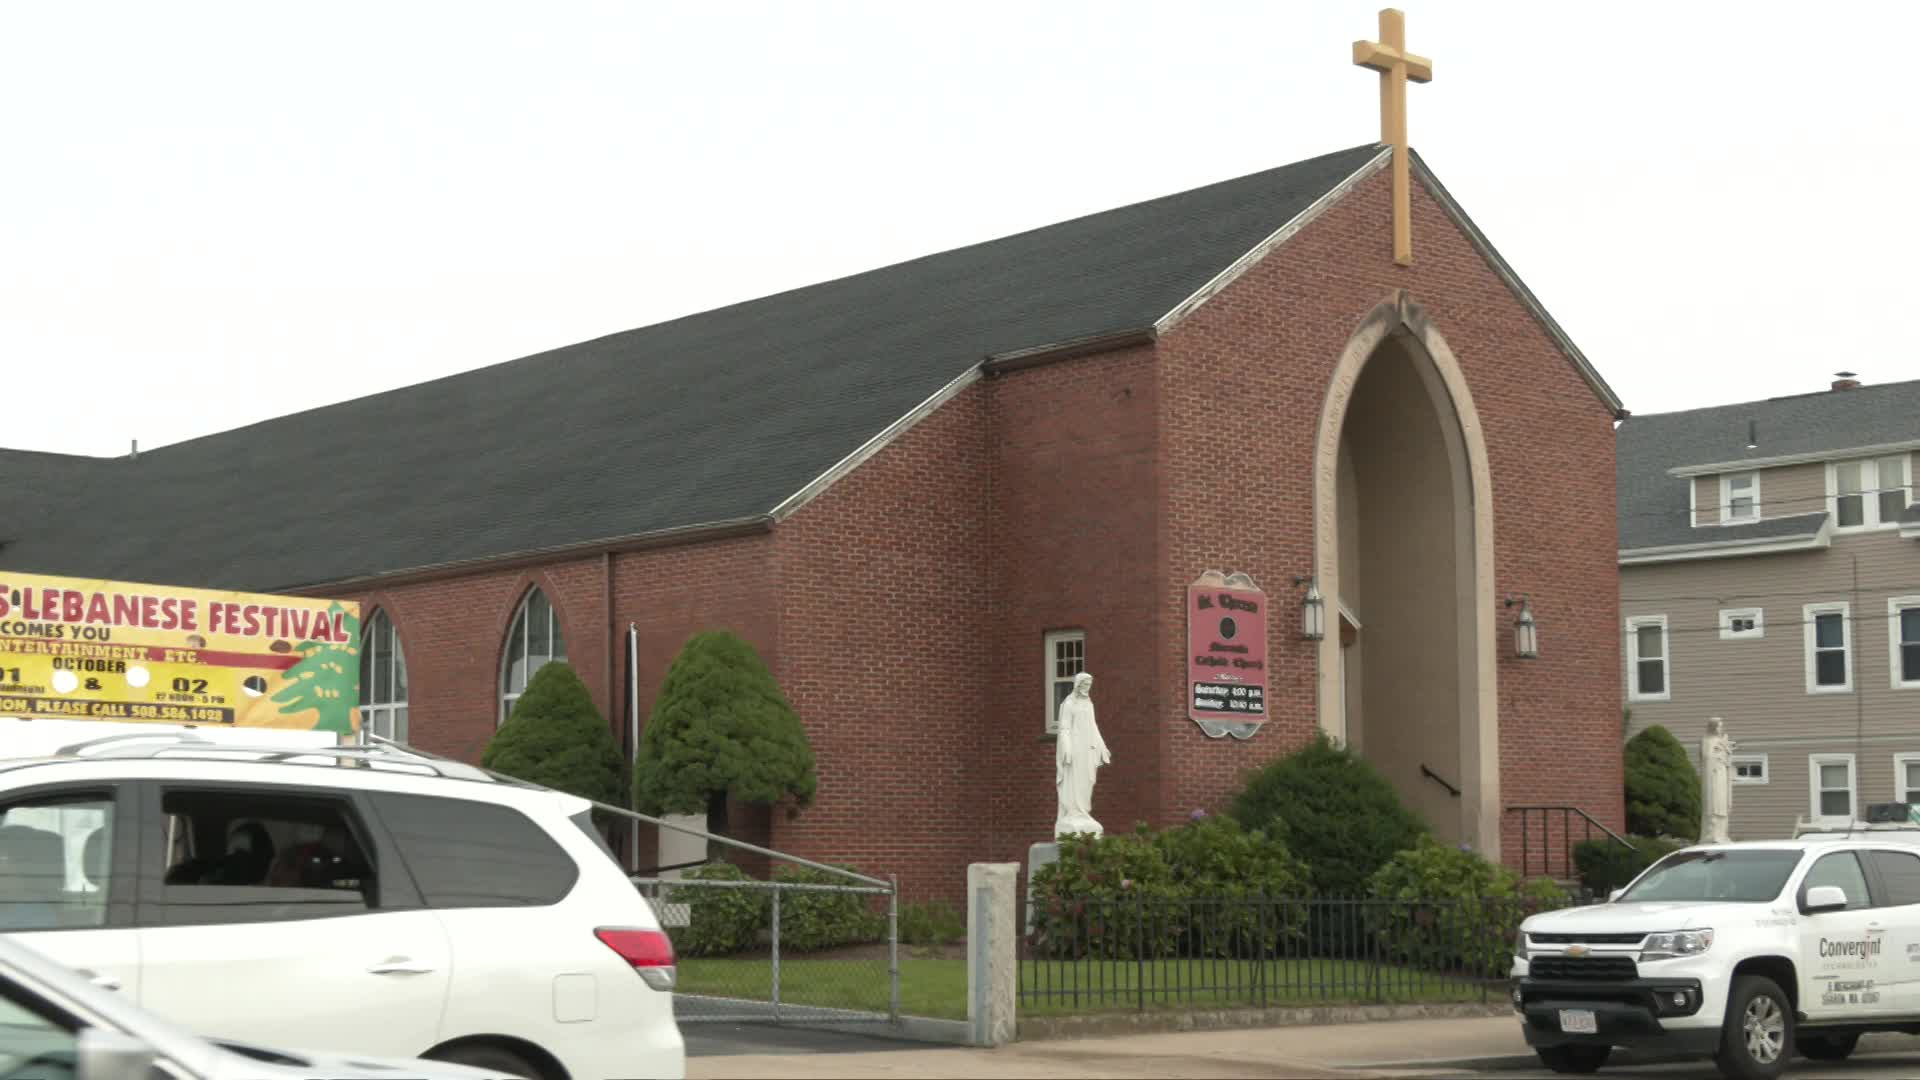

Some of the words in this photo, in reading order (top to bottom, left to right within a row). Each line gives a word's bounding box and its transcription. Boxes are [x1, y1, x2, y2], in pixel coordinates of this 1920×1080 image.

[22, 587, 198, 631] LEBANESE
[209, 602, 349, 643] FESTIVAL
[1, 621, 64, 638] COMES
[70, 626, 111, 641] YOU
[53, 657, 126, 673] OCTOBER
[84, 677, 103, 691] &
[172, 677, 209, 694] 02
[36, 700, 89, 714] PLEASE
[91, 703, 126, 717] CALL
[1819, 936, 1881, 960] Convergint
